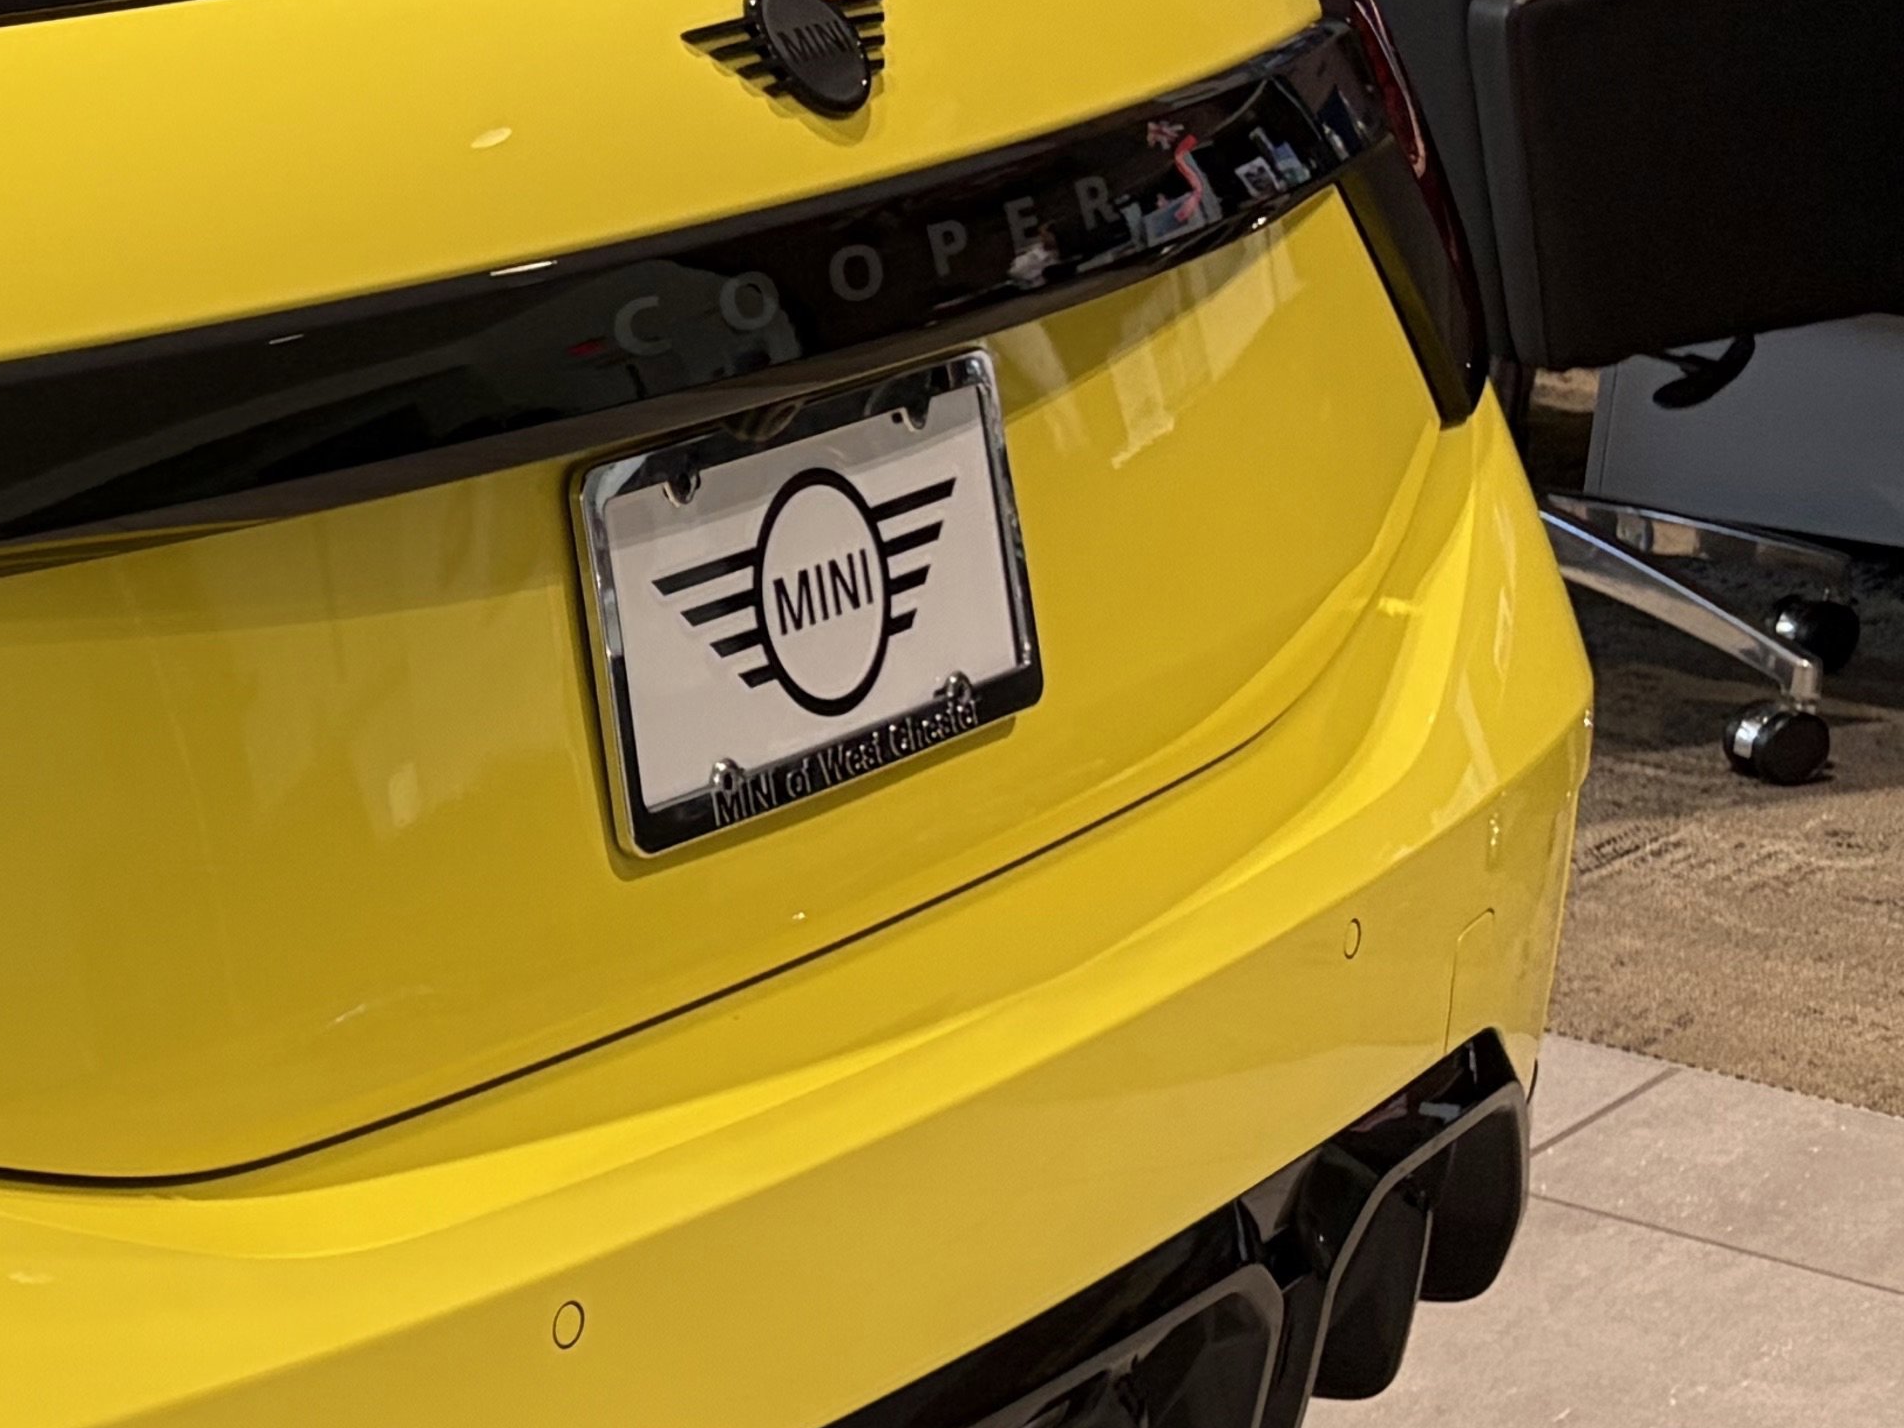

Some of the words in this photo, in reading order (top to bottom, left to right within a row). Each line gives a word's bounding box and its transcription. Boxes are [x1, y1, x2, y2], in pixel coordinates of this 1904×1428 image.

[777, 19, 853, 65] MINI
[772, 547, 874, 636] MINI
[710, 768, 778, 828] MINI
[785, 756, 812, 799] of
[817, 731, 884, 787] West
[888, 699, 979, 758] Chester
